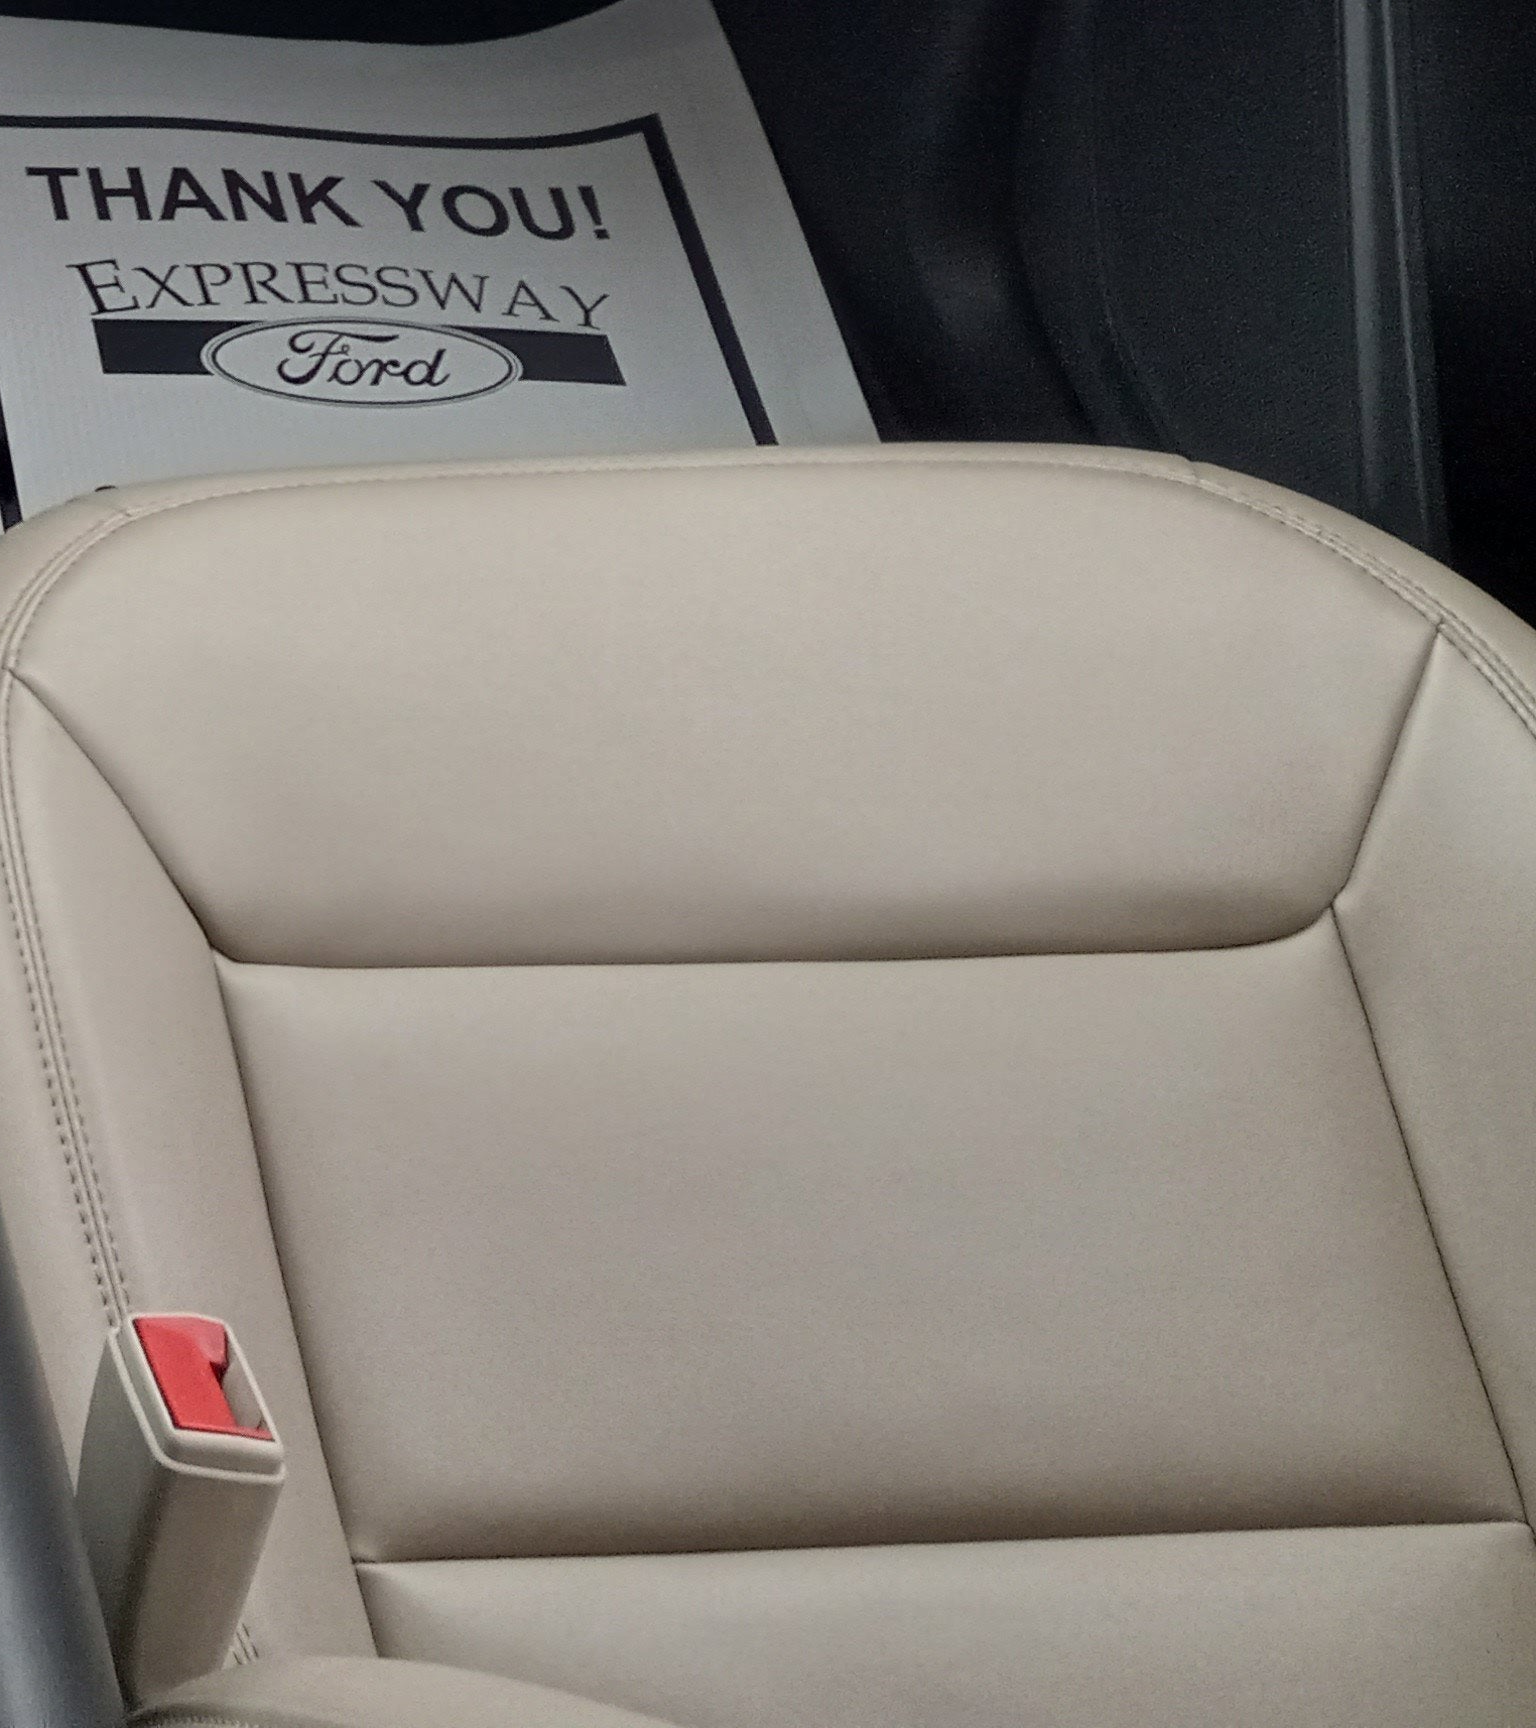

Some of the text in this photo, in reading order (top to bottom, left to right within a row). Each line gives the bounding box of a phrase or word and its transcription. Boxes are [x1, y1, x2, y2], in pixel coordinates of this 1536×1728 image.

[26, 166, 611, 241] THANK YOU!
[66, 259, 611, 330] EXPRESSWAY
[277, 328, 452, 389] Ford
